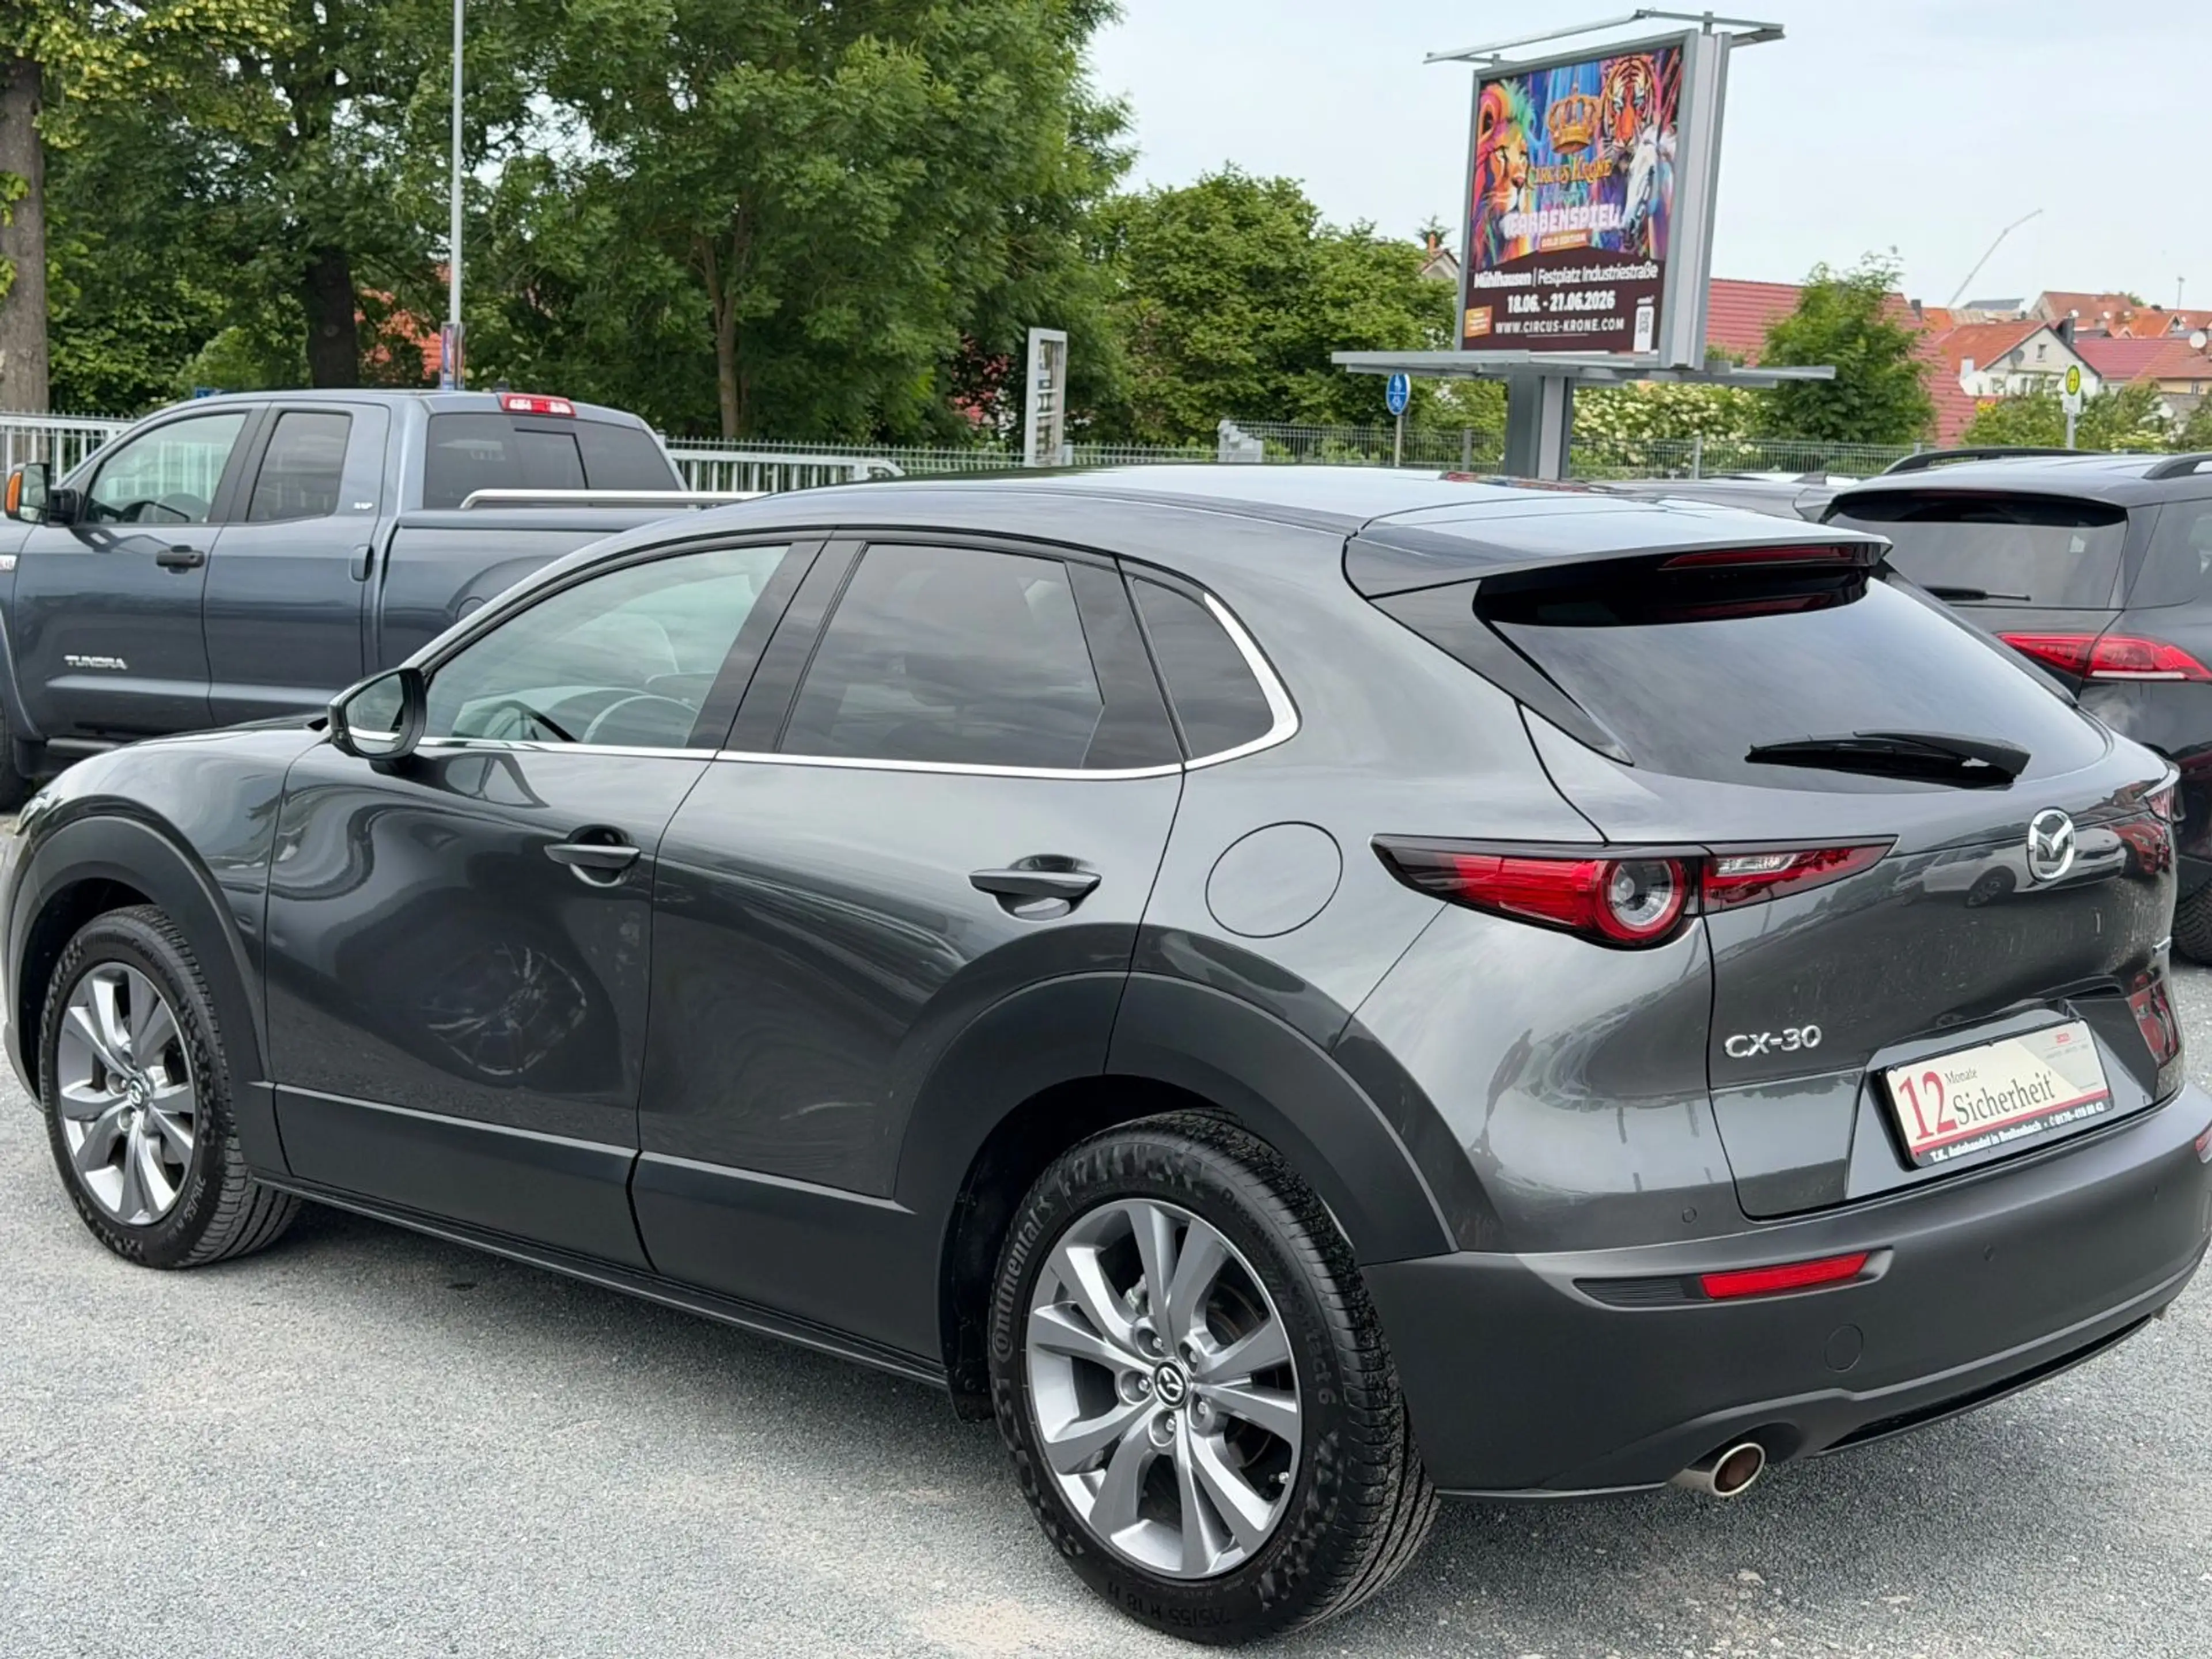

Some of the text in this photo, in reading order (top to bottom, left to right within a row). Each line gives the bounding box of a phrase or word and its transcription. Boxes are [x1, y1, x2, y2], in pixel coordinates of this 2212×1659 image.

[1474, 270, 1531, 288] Mühlhausen
[1538, 266, 1581, 287] Festplatz
[1583, 261, 1658, 282] Industriestraße
[1507, 294, 1540, 313] 18.06.
[1495, 318, 1624, 334] WWW.CIRCUS-KRONE.COM
[63, 655, 128, 670] TUNDRA
[1725, 1025, 1822, 1058] CX-30
[1944, 1067, 1978, 1086] Monate
[1899, 1071, 1957, 1140] 12
